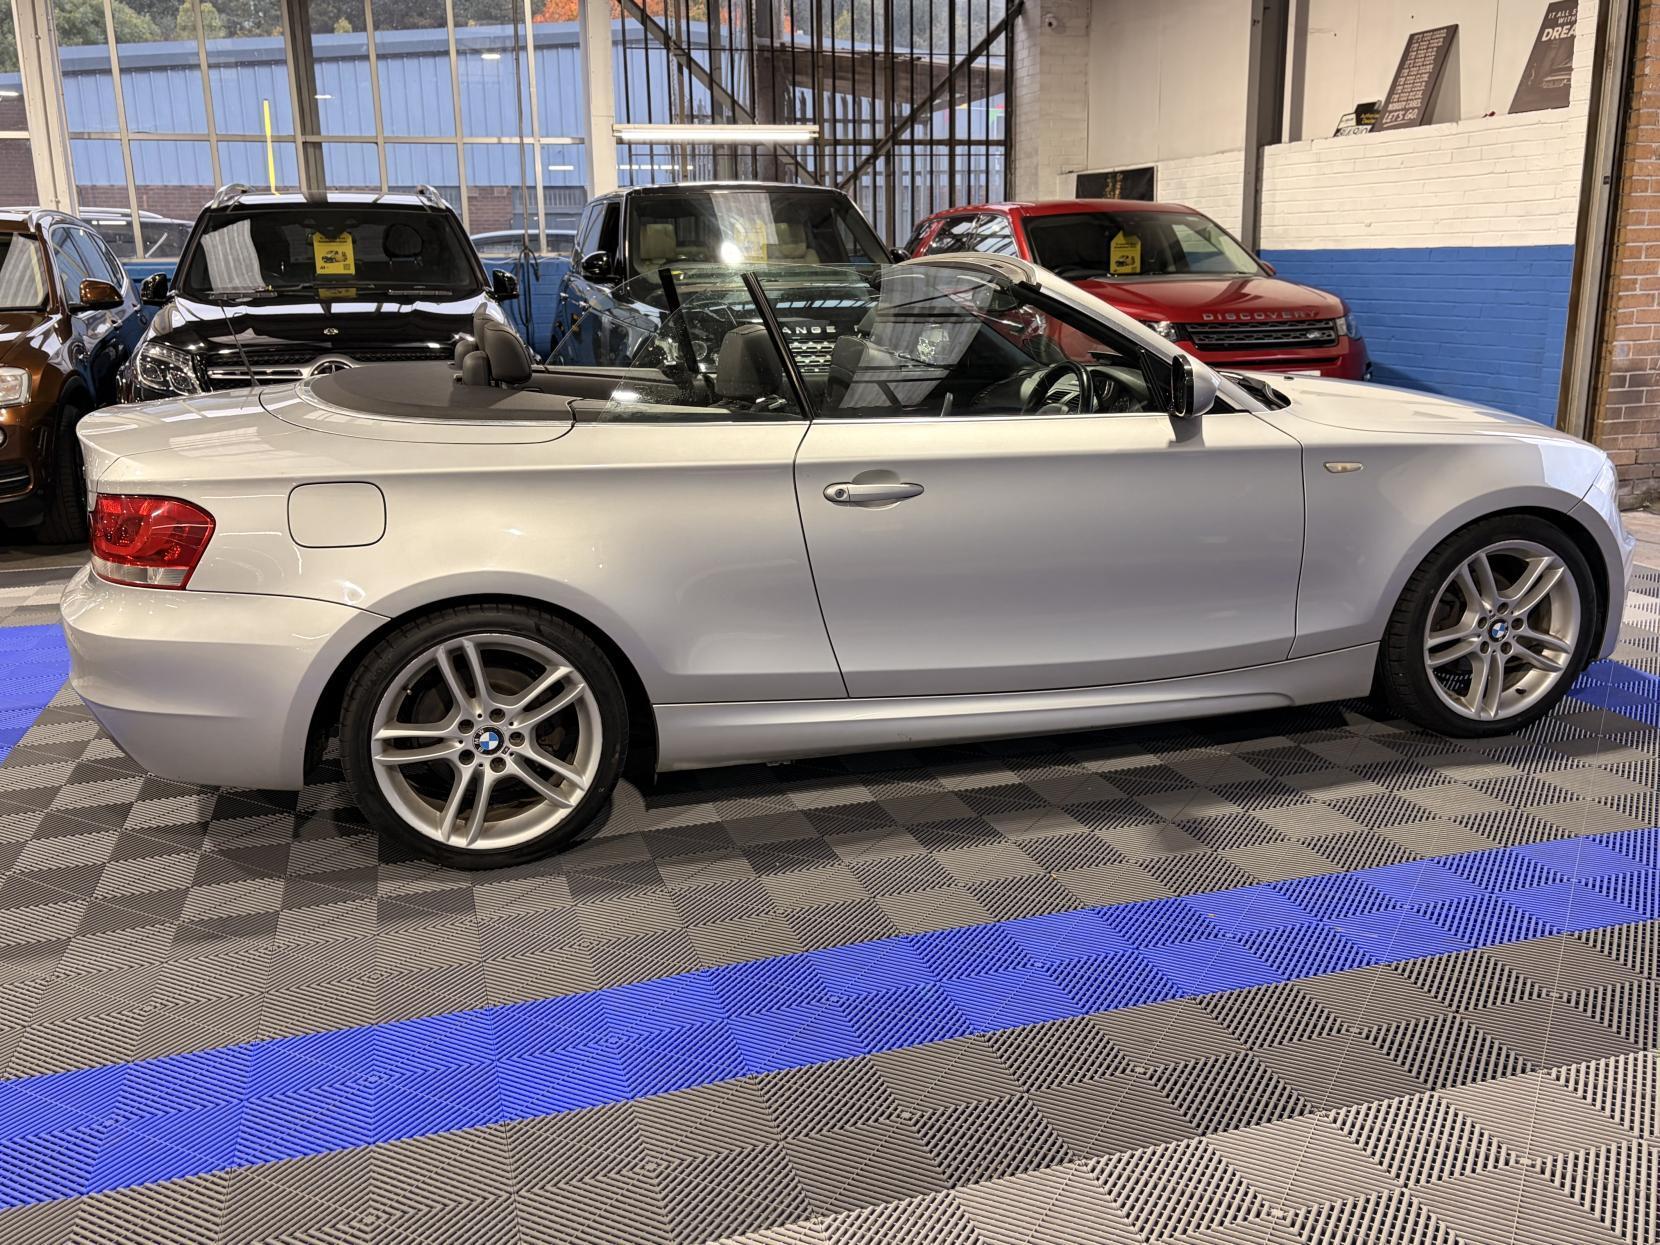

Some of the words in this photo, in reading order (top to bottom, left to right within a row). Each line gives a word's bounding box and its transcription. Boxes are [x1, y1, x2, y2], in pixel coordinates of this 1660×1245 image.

[1558, 16, 1577, 24] WITH
[1541, 25, 1576, 41] DREA
[1382, 110, 1405, 123] LET'S
[1202, 311, 1317, 320] DISCOVERY
[782, 326, 837, 334] ANGE
